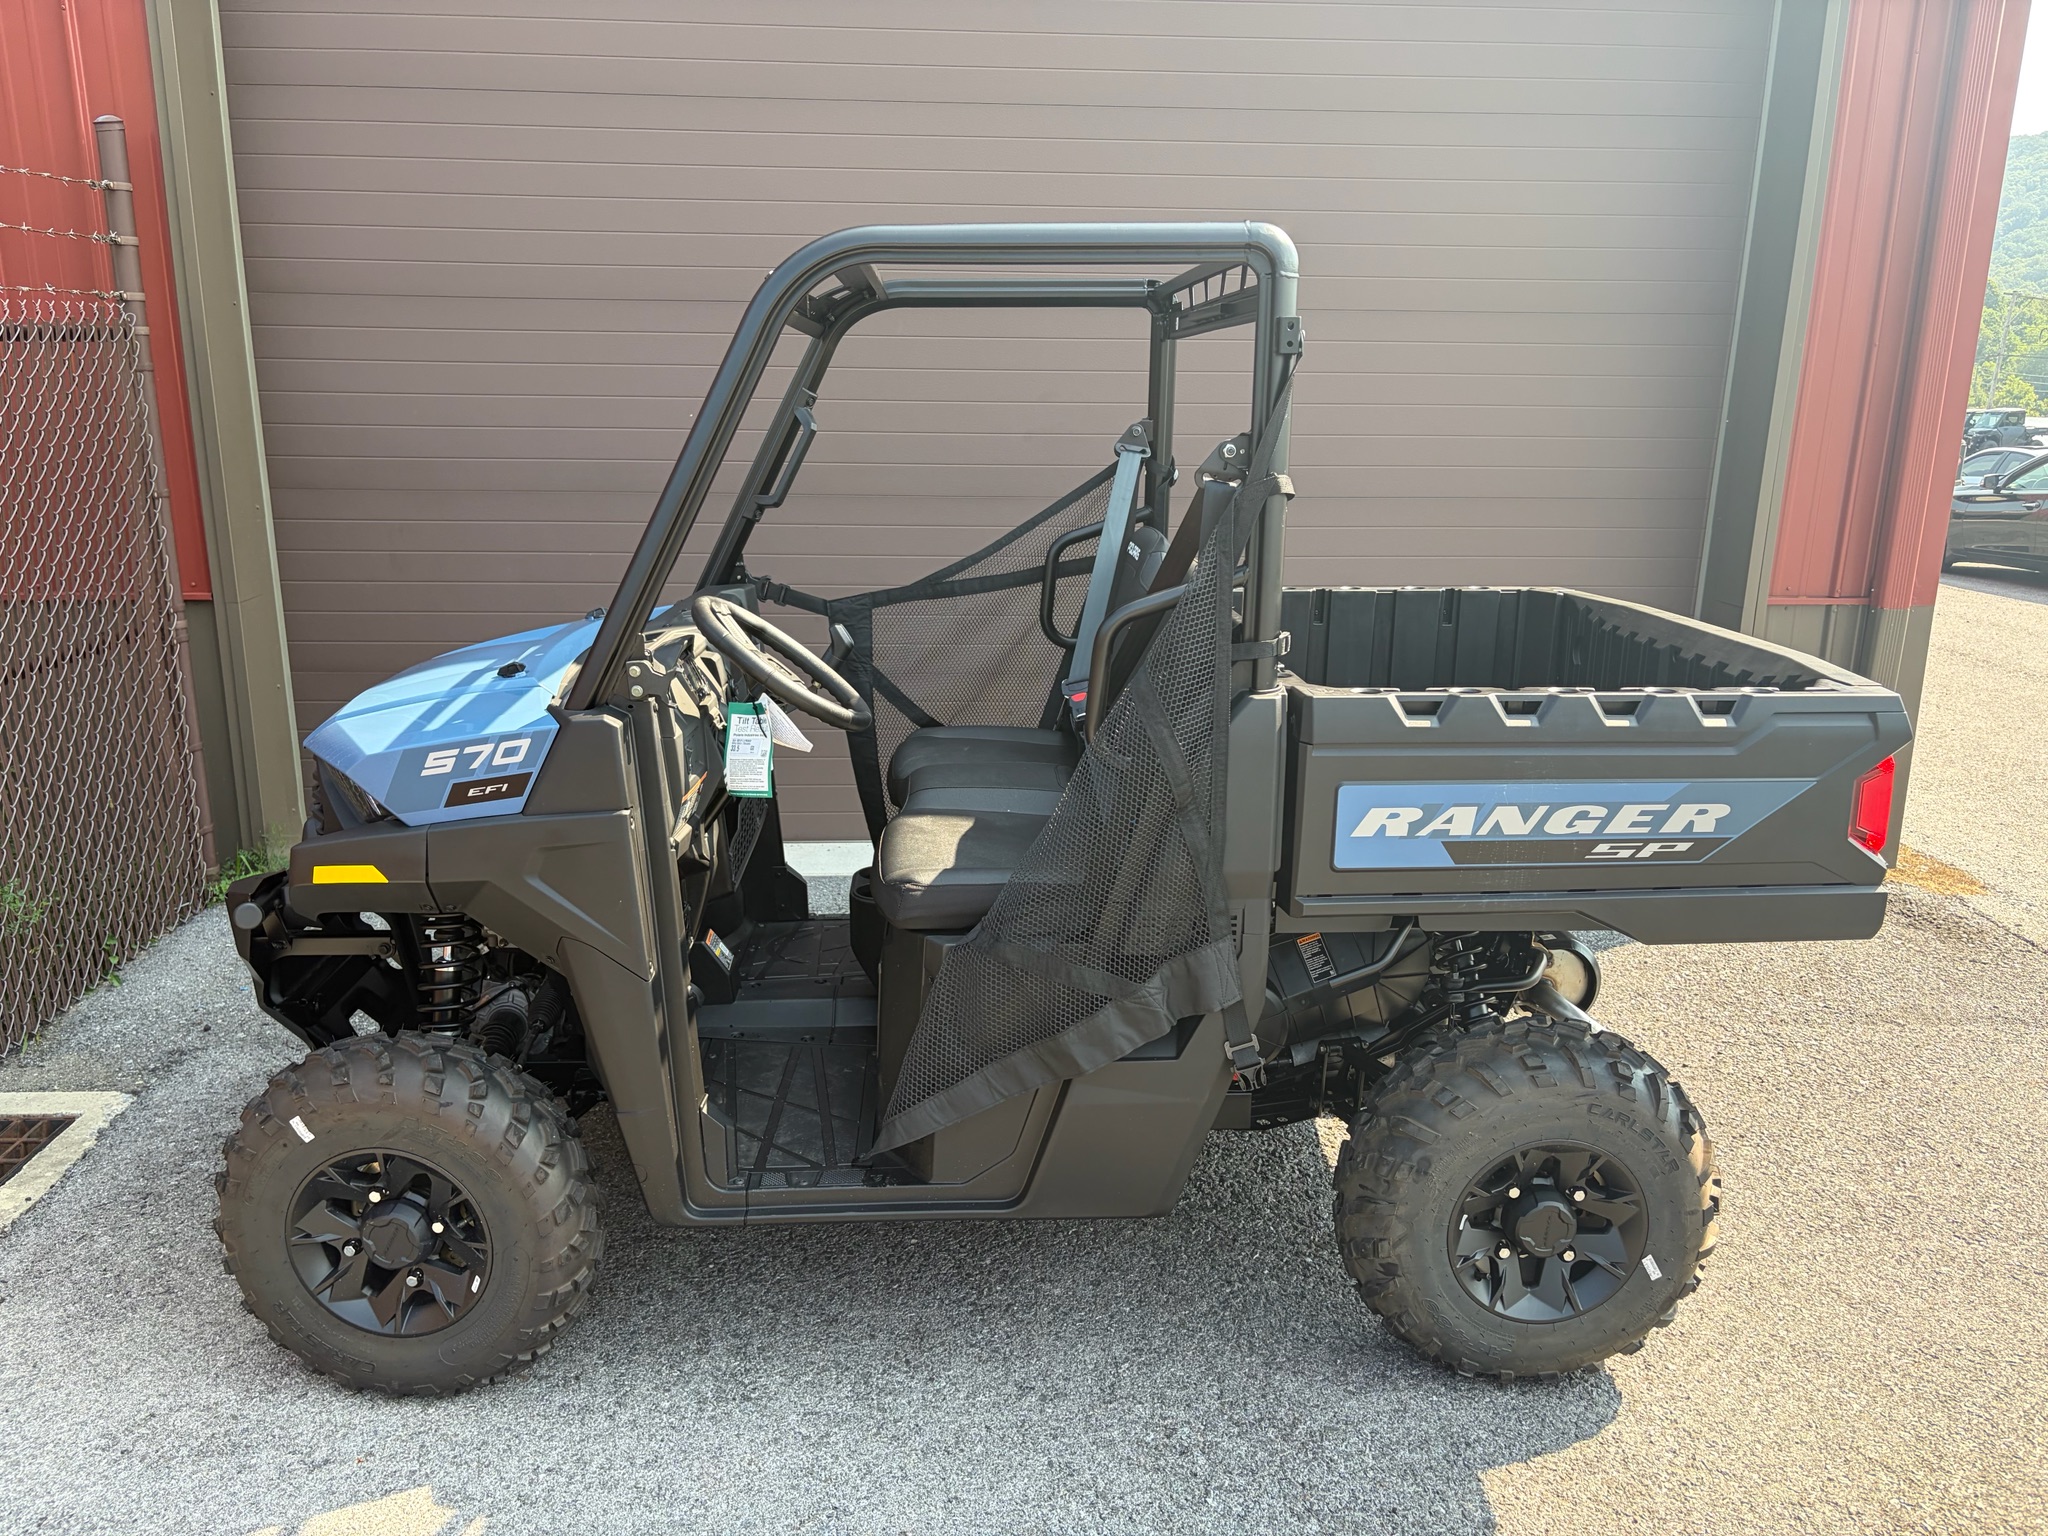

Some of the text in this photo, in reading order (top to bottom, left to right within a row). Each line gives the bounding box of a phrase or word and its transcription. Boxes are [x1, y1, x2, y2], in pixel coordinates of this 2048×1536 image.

[1127, 541, 1141, 561] POLARIS
[734, 724, 749, 733] Test
[737, 716, 750, 725] Tilt
[420, 738, 531, 776] 570
[467, 783, 508, 797] EFI
[1350, 803, 1731, 838] RANGER
[1585, 842, 1694, 859] SP
[1302, 933, 1320, 942] WARNING
[1587, 1103, 1680, 1176] CARLSTAR
[272, 1299, 377, 1376] CARLSTAR
